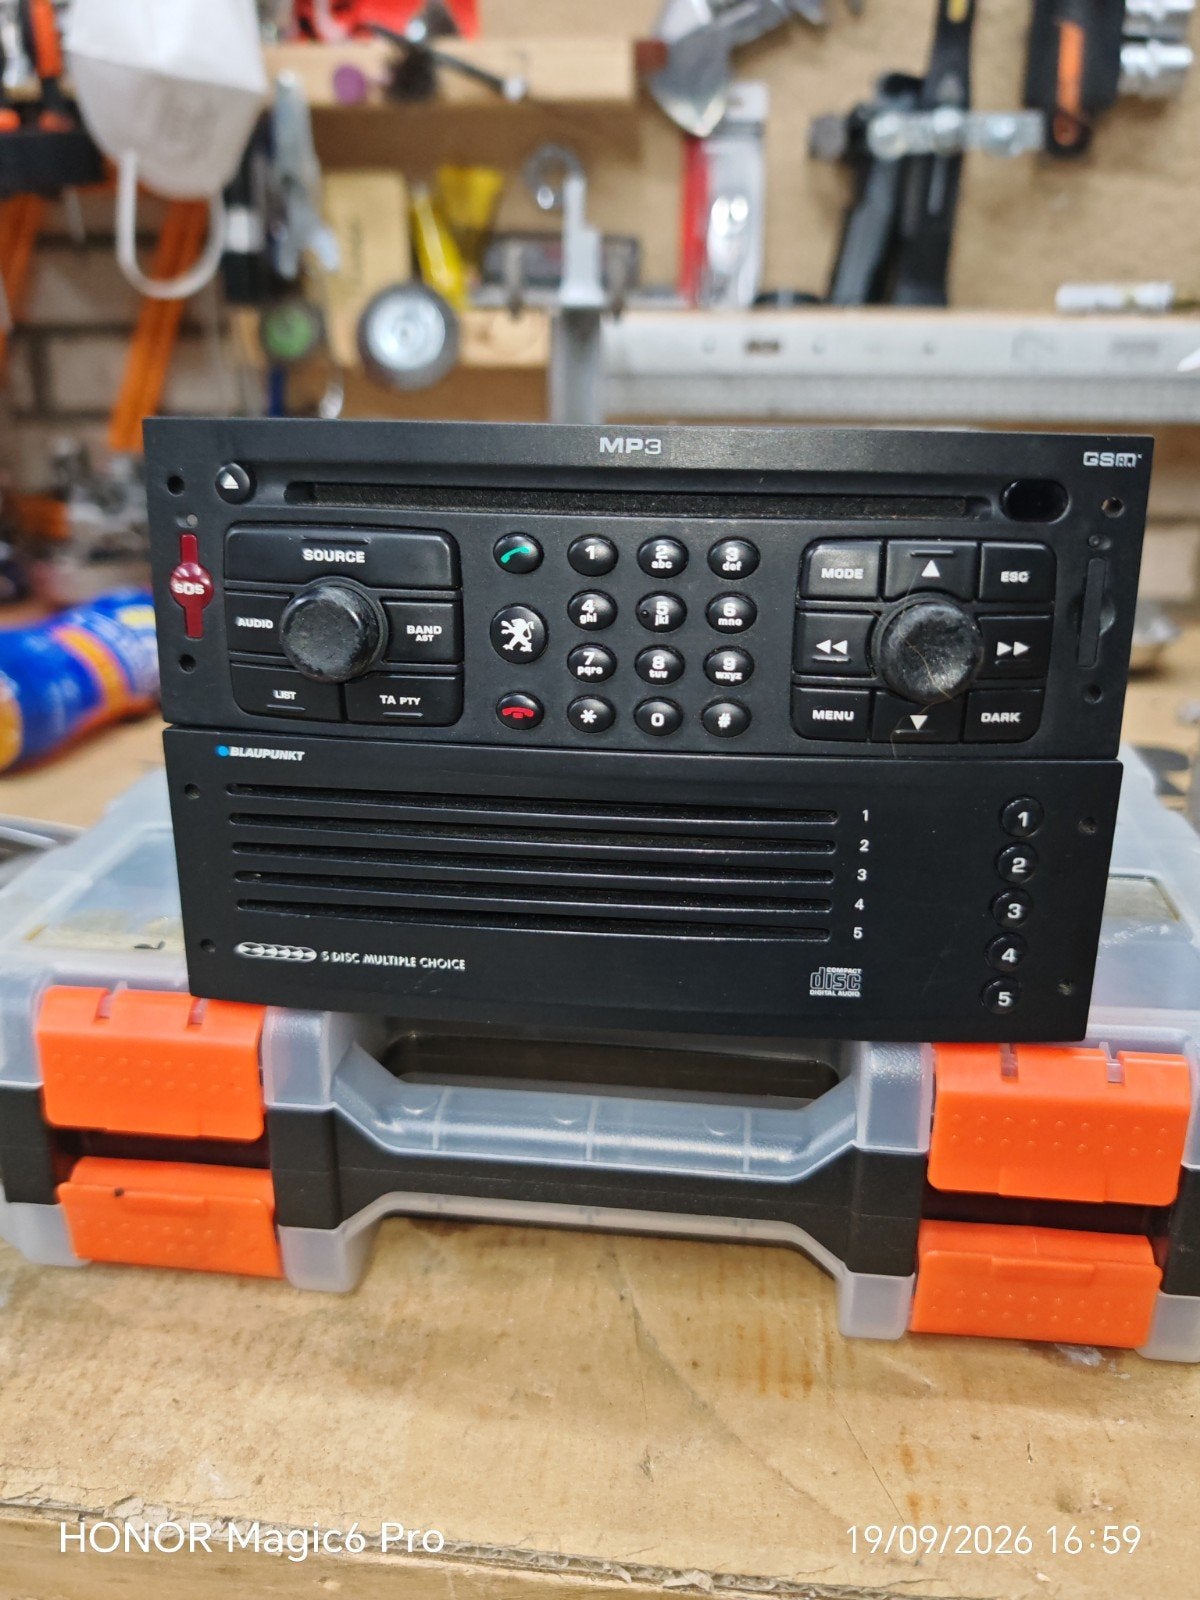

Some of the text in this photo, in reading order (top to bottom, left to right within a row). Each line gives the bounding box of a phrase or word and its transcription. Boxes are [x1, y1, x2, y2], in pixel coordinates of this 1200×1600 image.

[599, 437, 662, 454] MP3
[303, 549, 365, 563] SOURCE
[585, 546, 594, 560] 1
[656, 547, 667, 560] 2
[726, 547, 738, 561] 3
[651, 560, 672, 569] abc
[722, 561, 742, 571] def
[821, 568, 863, 580] MODE
[1000, 571, 1029, 582] ESC
[174, 583, 204, 595] SOS
[582, 600, 594, 614] 4
[656, 602, 668, 615] 5
[724, 604, 736, 616] 6
[237, 617, 273, 628] AUDIO
[580, 614, 597, 624] ghi
[655, 615, 668, 626] jkl
[718, 616, 742, 626] mno
[407, 625, 442, 635] BAND
[583, 652, 594, 665] 7
[653, 656, 664, 669] 8
[723, 657, 735, 670] 9
[649, 669, 667, 678] tuv
[715, 671, 742, 681] wxyz
[274, 691, 296, 701] LIST
[380, 695, 421, 706] TA PTY
[812, 710, 854, 721] MENU
[981, 712, 1021, 723] DARK
[229, 747, 304, 761] BLAUPUNKT
[862, 810, 869, 821] 1
[1017, 812, 1028, 827] 1
[860, 840, 869, 852] 2
[1012, 858, 1025, 874] 2
[857, 869, 867, 881] 3
[854, 899, 864, 910] 4
[1007, 904, 1022, 919] 3
[853, 927, 862, 939] 5
[321, 951, 465, 970] 5 DISC MULTIPLE CHOICE
[1001, 948, 1015, 963] 4
[810, 967, 860, 990] disc
[998, 991, 1012, 1006] 5
